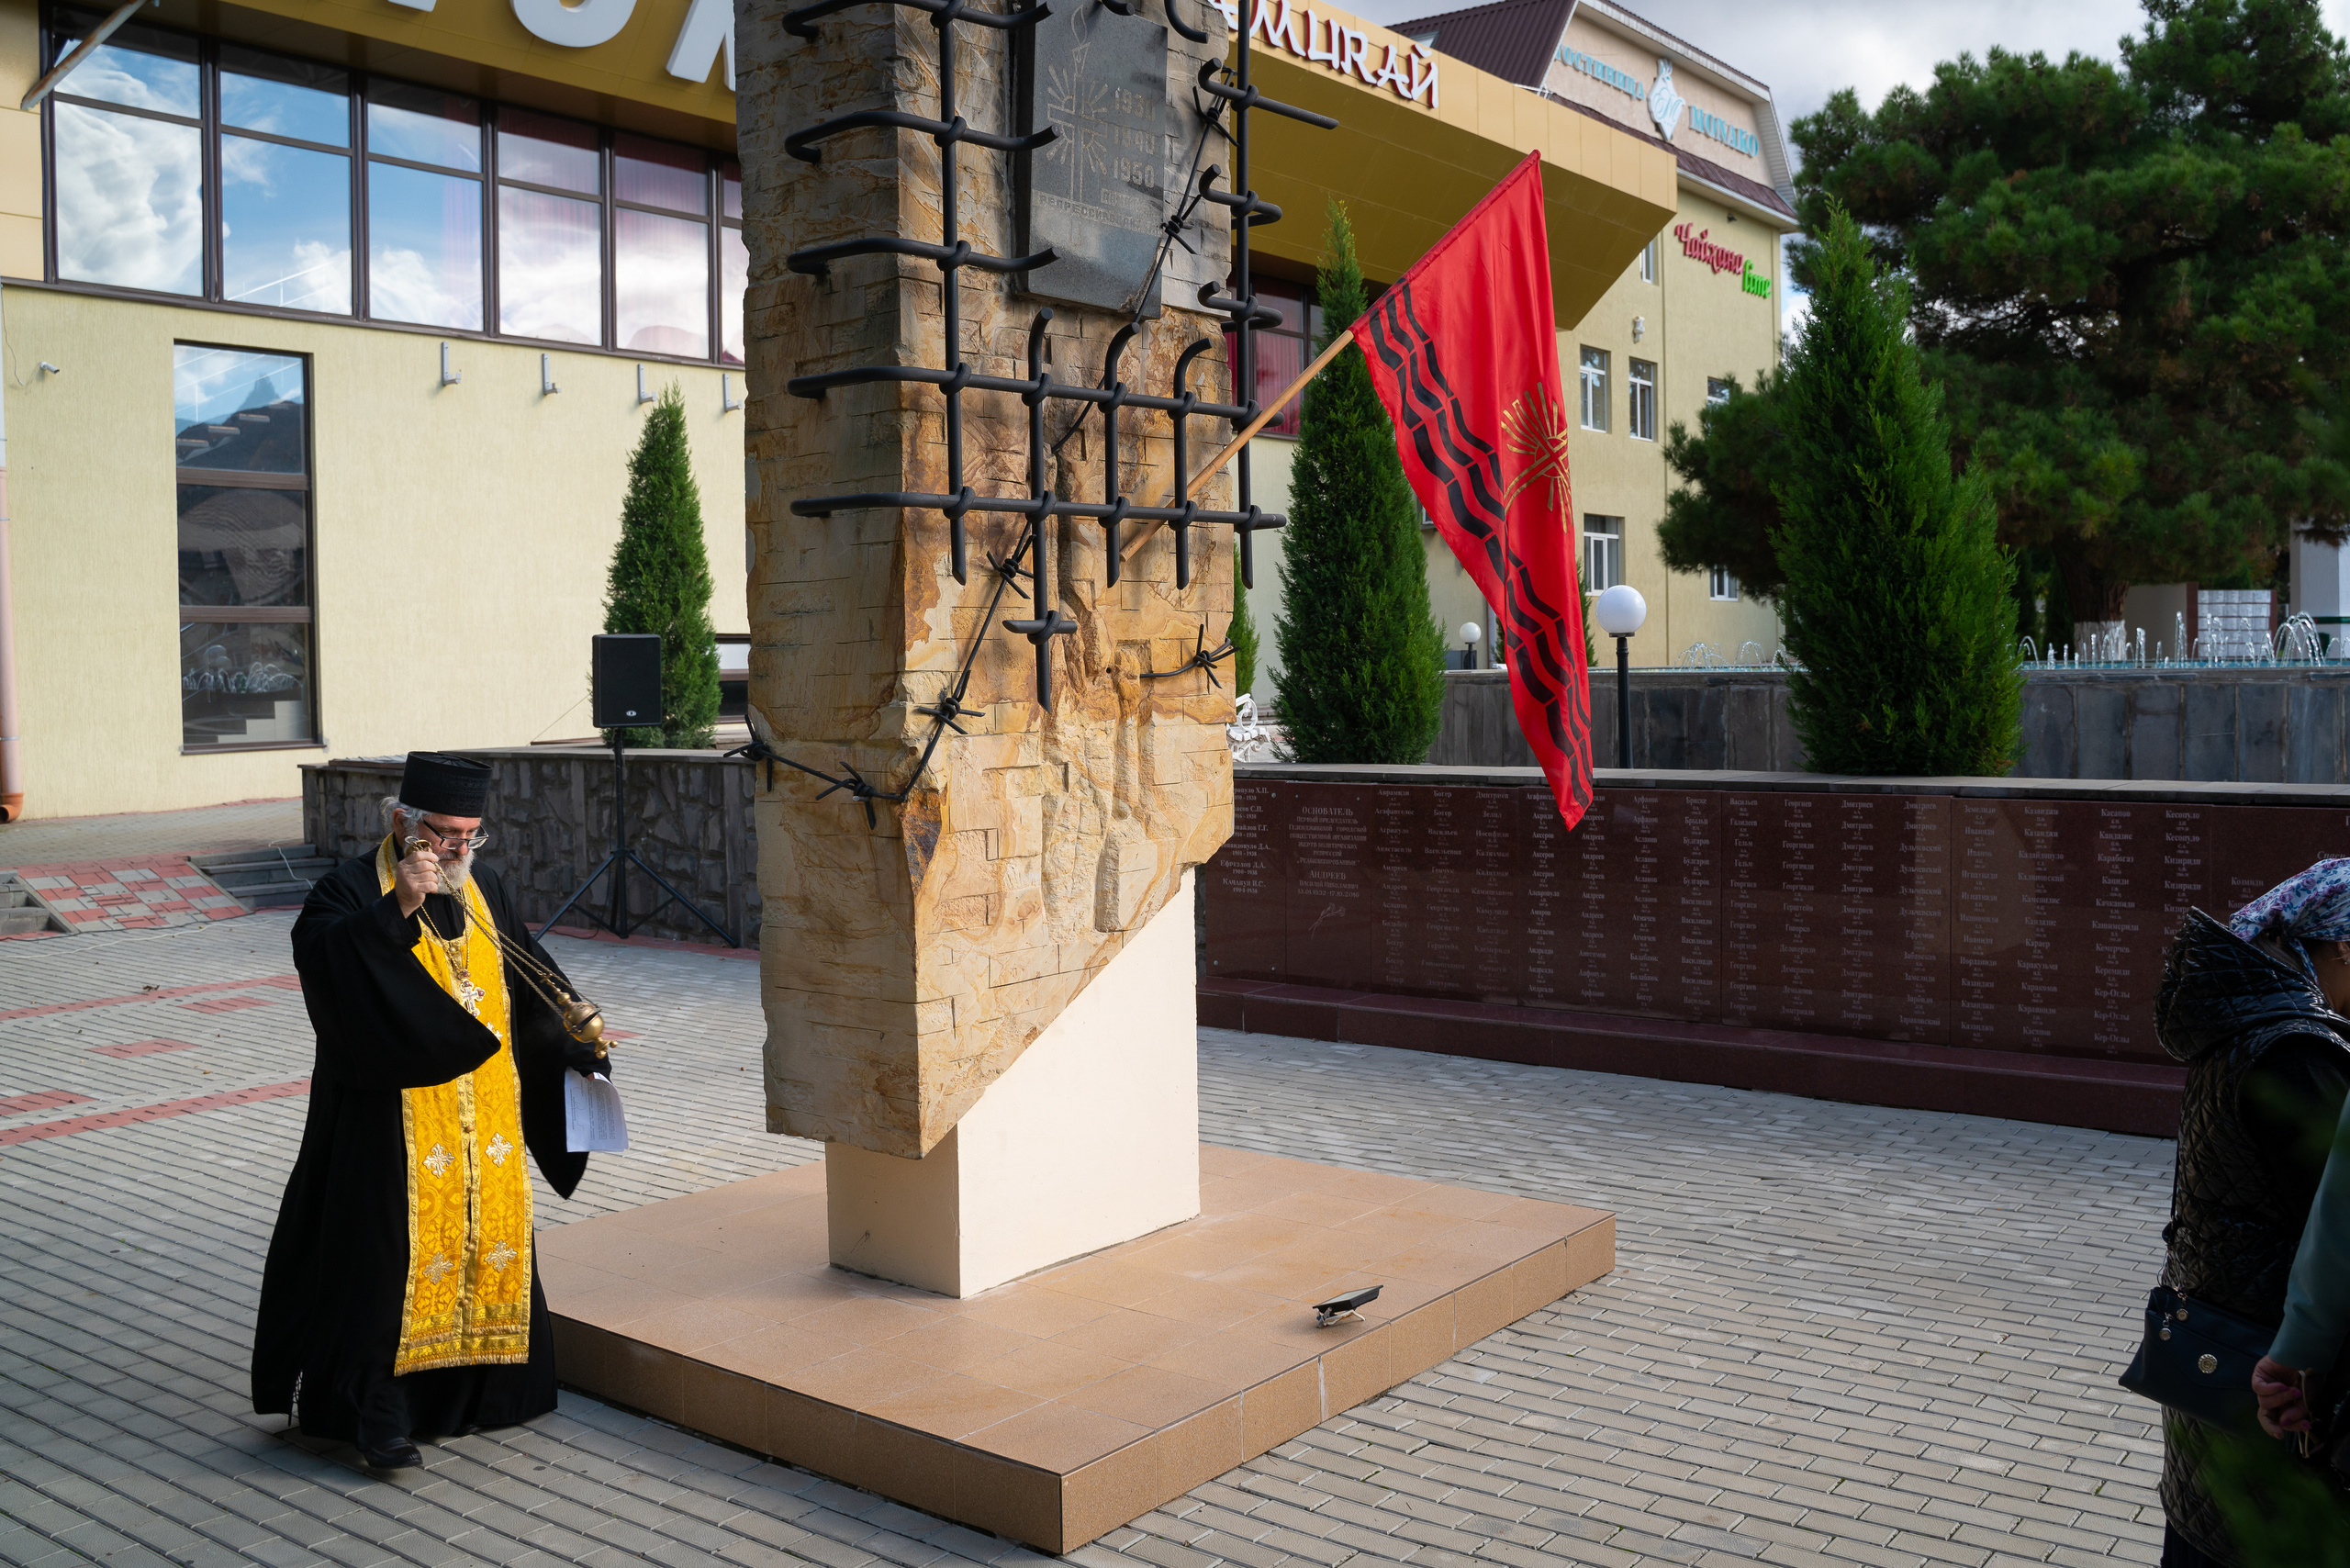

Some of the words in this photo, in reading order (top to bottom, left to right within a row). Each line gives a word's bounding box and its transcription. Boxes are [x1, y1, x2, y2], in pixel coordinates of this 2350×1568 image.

[1688, 104, 1759, 159] MONAKO
[1113, 125, 1156, 156] 1940
[1113, 157, 1155, 188] 1950
[1674, 222, 1744, 275] Чайхана
[1433, 790, 1452, 798] Богер
[1903, 801, 1937, 812] Дмитриев
[1433, 809, 1452, 817] Богер
[2100, 808, 2132, 818] Касапов
[1903, 821, 1937, 832] Дмитриев
[2024, 828, 2059, 838] Казанджи
[2097, 853, 2134, 864] Карабогаз
